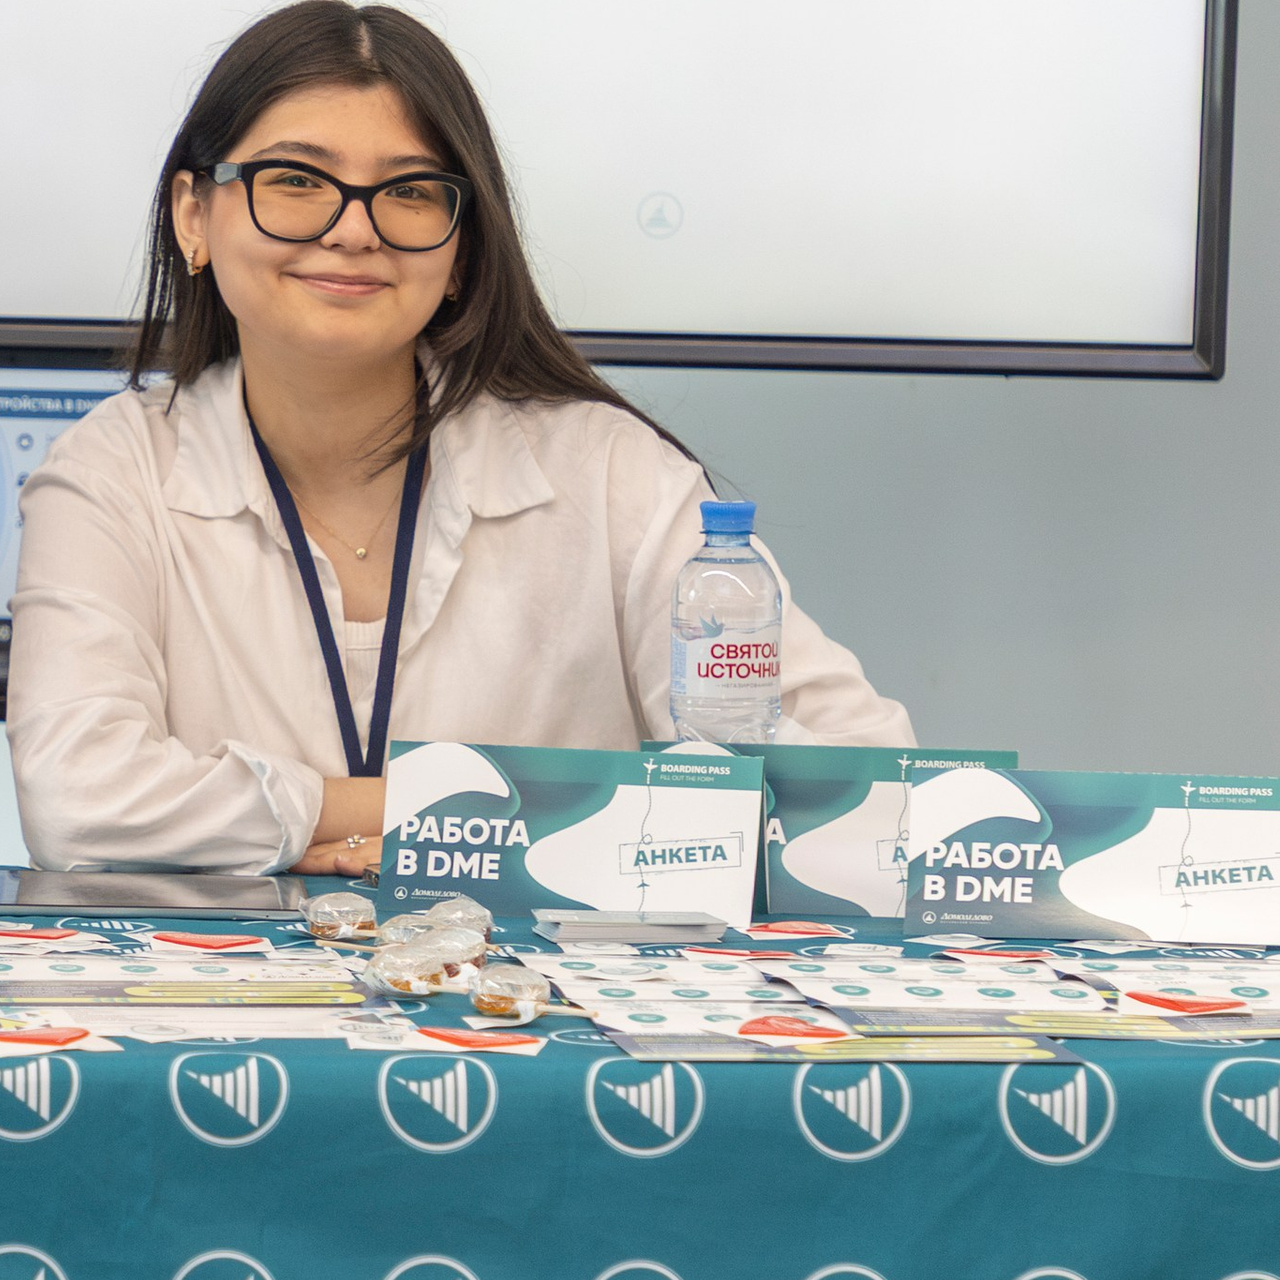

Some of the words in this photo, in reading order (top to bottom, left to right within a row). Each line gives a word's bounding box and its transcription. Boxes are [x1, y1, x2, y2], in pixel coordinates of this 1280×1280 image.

[661, 764, 707, 775] BOARDING
[709, 765, 730, 775] PASS
[915, 760, 962, 768] BOARDING
[964, 761, 985, 769] PASS
[671, 774, 684, 782] OUT
[1199, 787, 1248, 796] BOARDING
[1250, 788, 1273, 796] PASS
[399, 816, 530, 847] РАБОТА
[396, 849, 419, 876] В
[426, 850, 500, 881] DME
[633, 844, 728, 867] АНКЕТА
[925, 842, 1065, 871] РАБОТА
[1175, 865, 1275, 888] АНКЕТА
[924, 875, 945, 901] В
[956, 876, 1033, 904] DME
